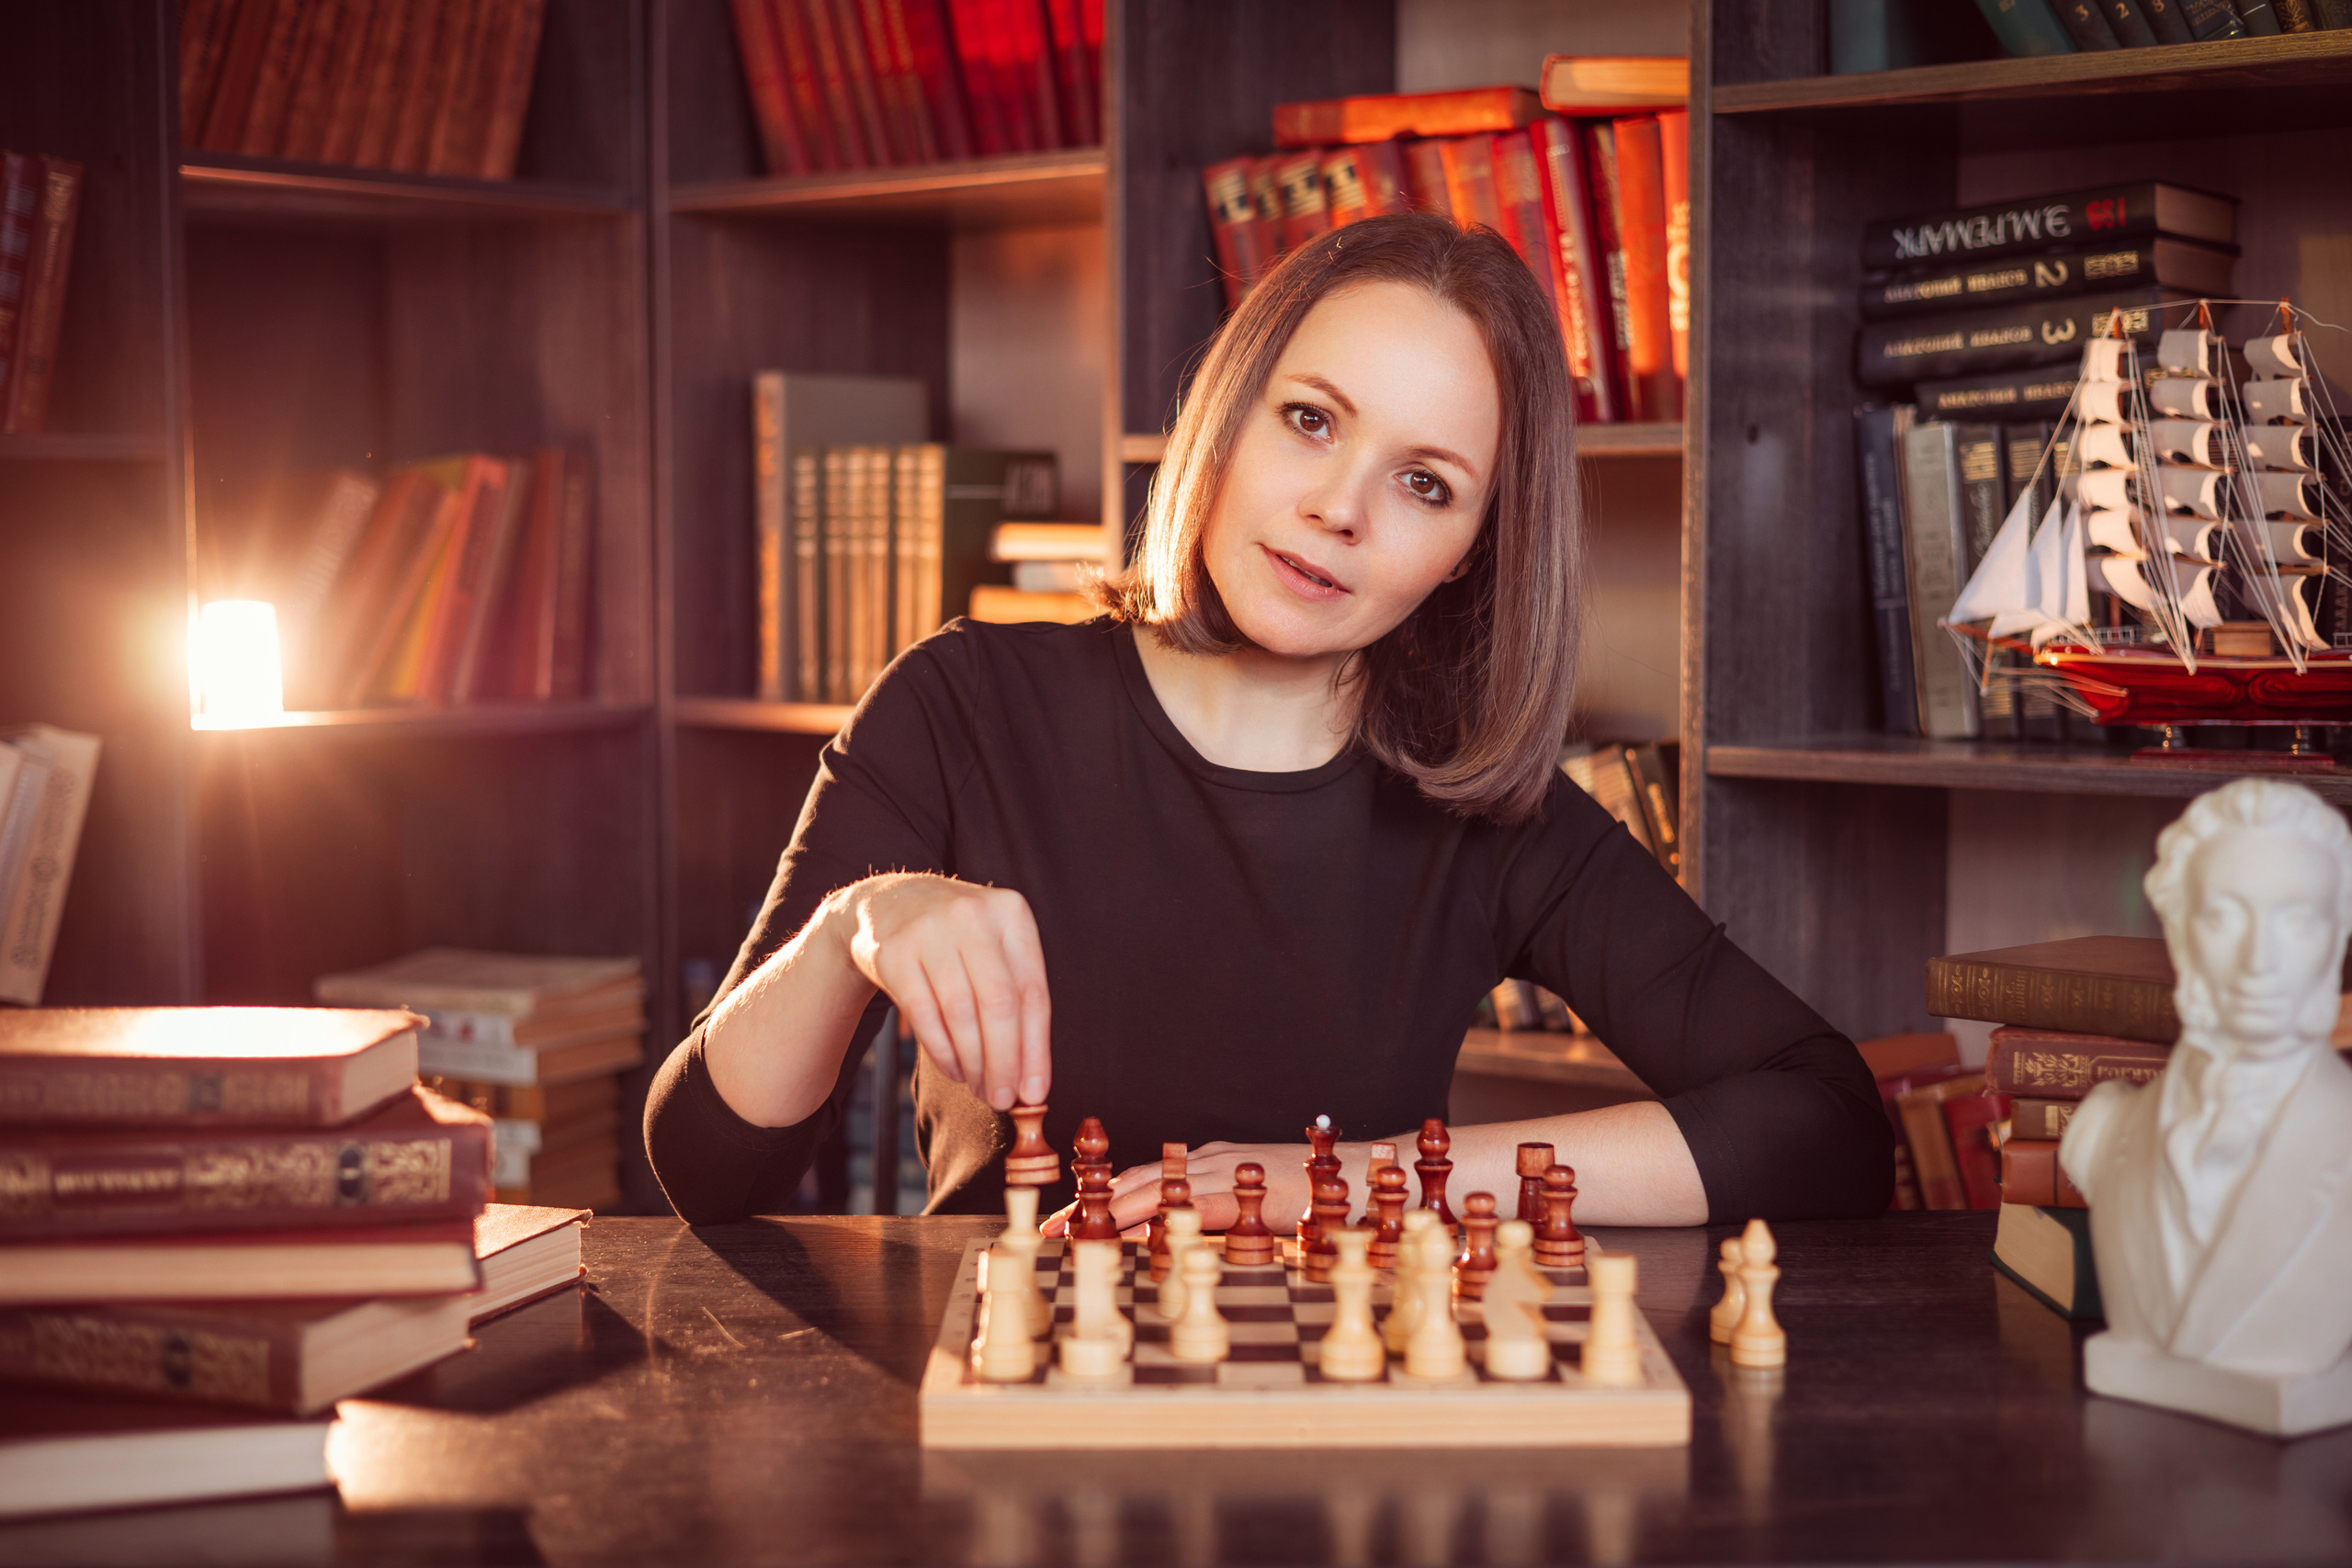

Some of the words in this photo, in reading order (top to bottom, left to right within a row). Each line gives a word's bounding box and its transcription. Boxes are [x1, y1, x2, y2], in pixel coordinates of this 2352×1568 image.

[2115, 2, 2132, 19] 2
[1883, 275, 1962, 304] АНАТОЛИЙ
[1967, 268, 2029, 292] ИВАНОВ
[2034, 260, 2068, 288] 2
[1884, 331, 1964, 358] АНАТОЛИЙ
[1970, 325, 2033, 348] ИВАНОВ
[2041, 318, 2076, 345] 3
[1938, 385, 2018, 411] АНАТОЛИЙ
[2023, 380, 2080, 402] ИВАНО
